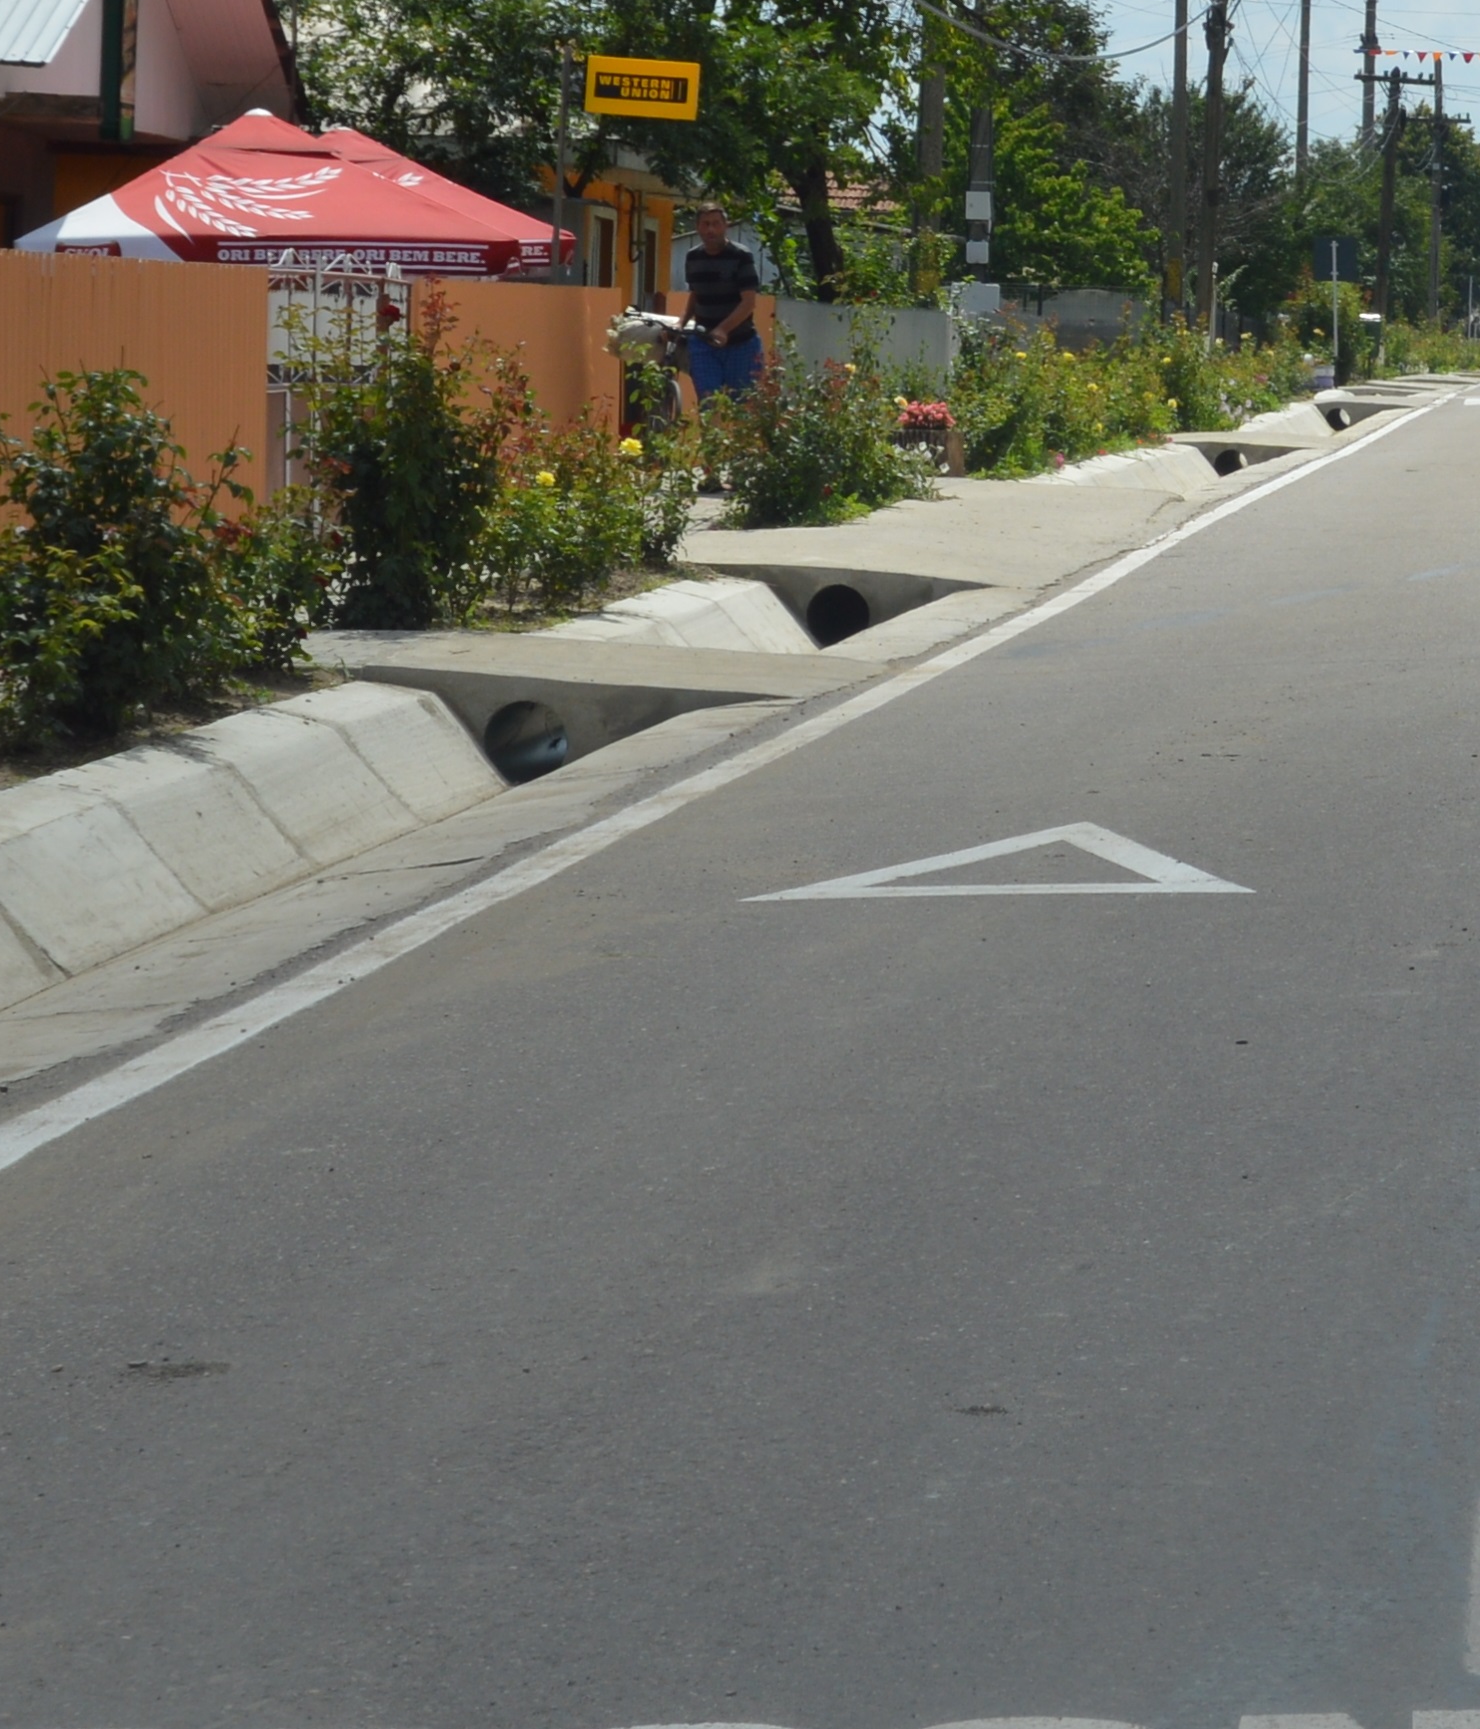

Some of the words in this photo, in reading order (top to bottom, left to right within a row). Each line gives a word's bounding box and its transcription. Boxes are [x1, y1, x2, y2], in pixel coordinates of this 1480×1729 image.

[599, 75, 671, 90] WESTERN
[620, 87, 671, 100] UNION
[217, 249, 250, 261] ORI
[353, 249, 385, 261] ORI
[389, 250, 429, 262] BEM
[432, 251, 486, 264] BERE.
